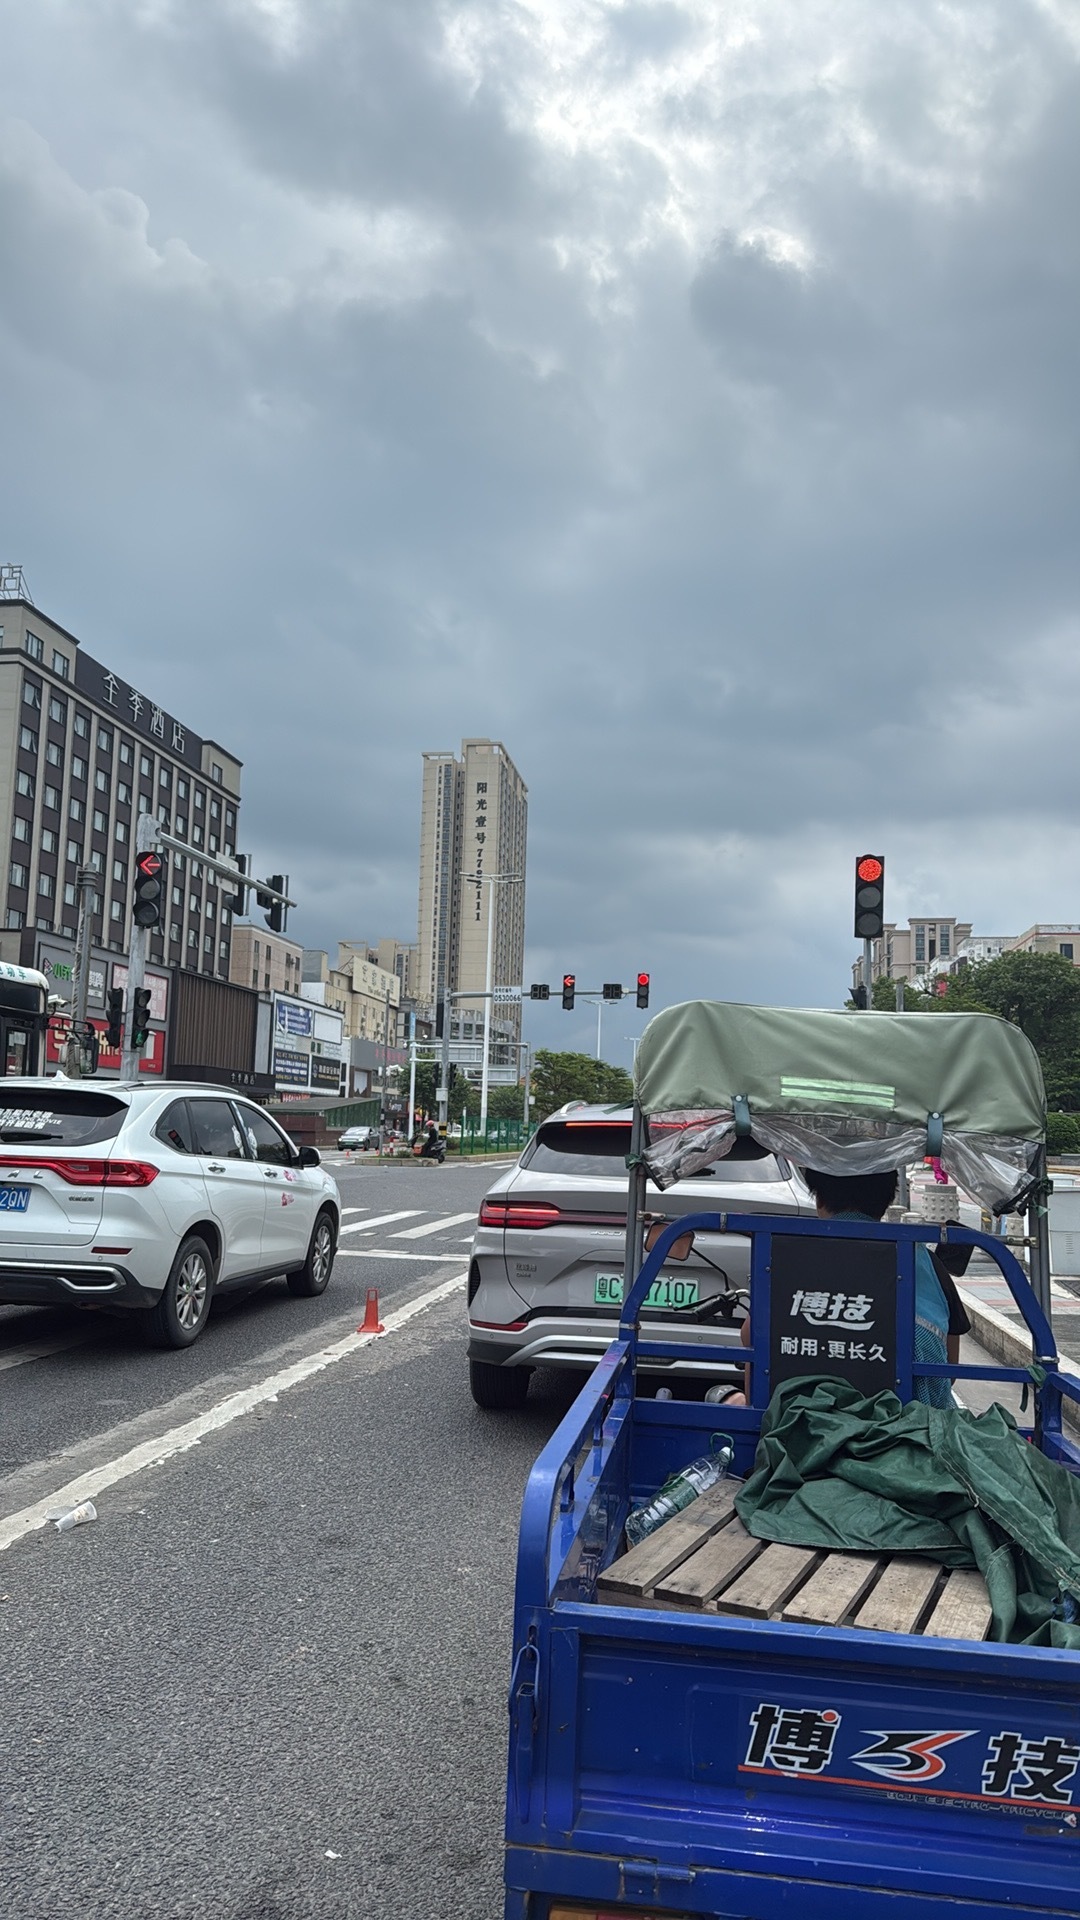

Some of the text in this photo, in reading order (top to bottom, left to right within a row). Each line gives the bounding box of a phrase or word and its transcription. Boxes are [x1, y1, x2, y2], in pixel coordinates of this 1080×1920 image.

[103, 673, 185, 754] 全季酒店
[475, 782, 487, 844] 阳光壹号
[598, 1277, 697, 1304] 粤C7107
[789, 1290, 875, 1331] 博技
